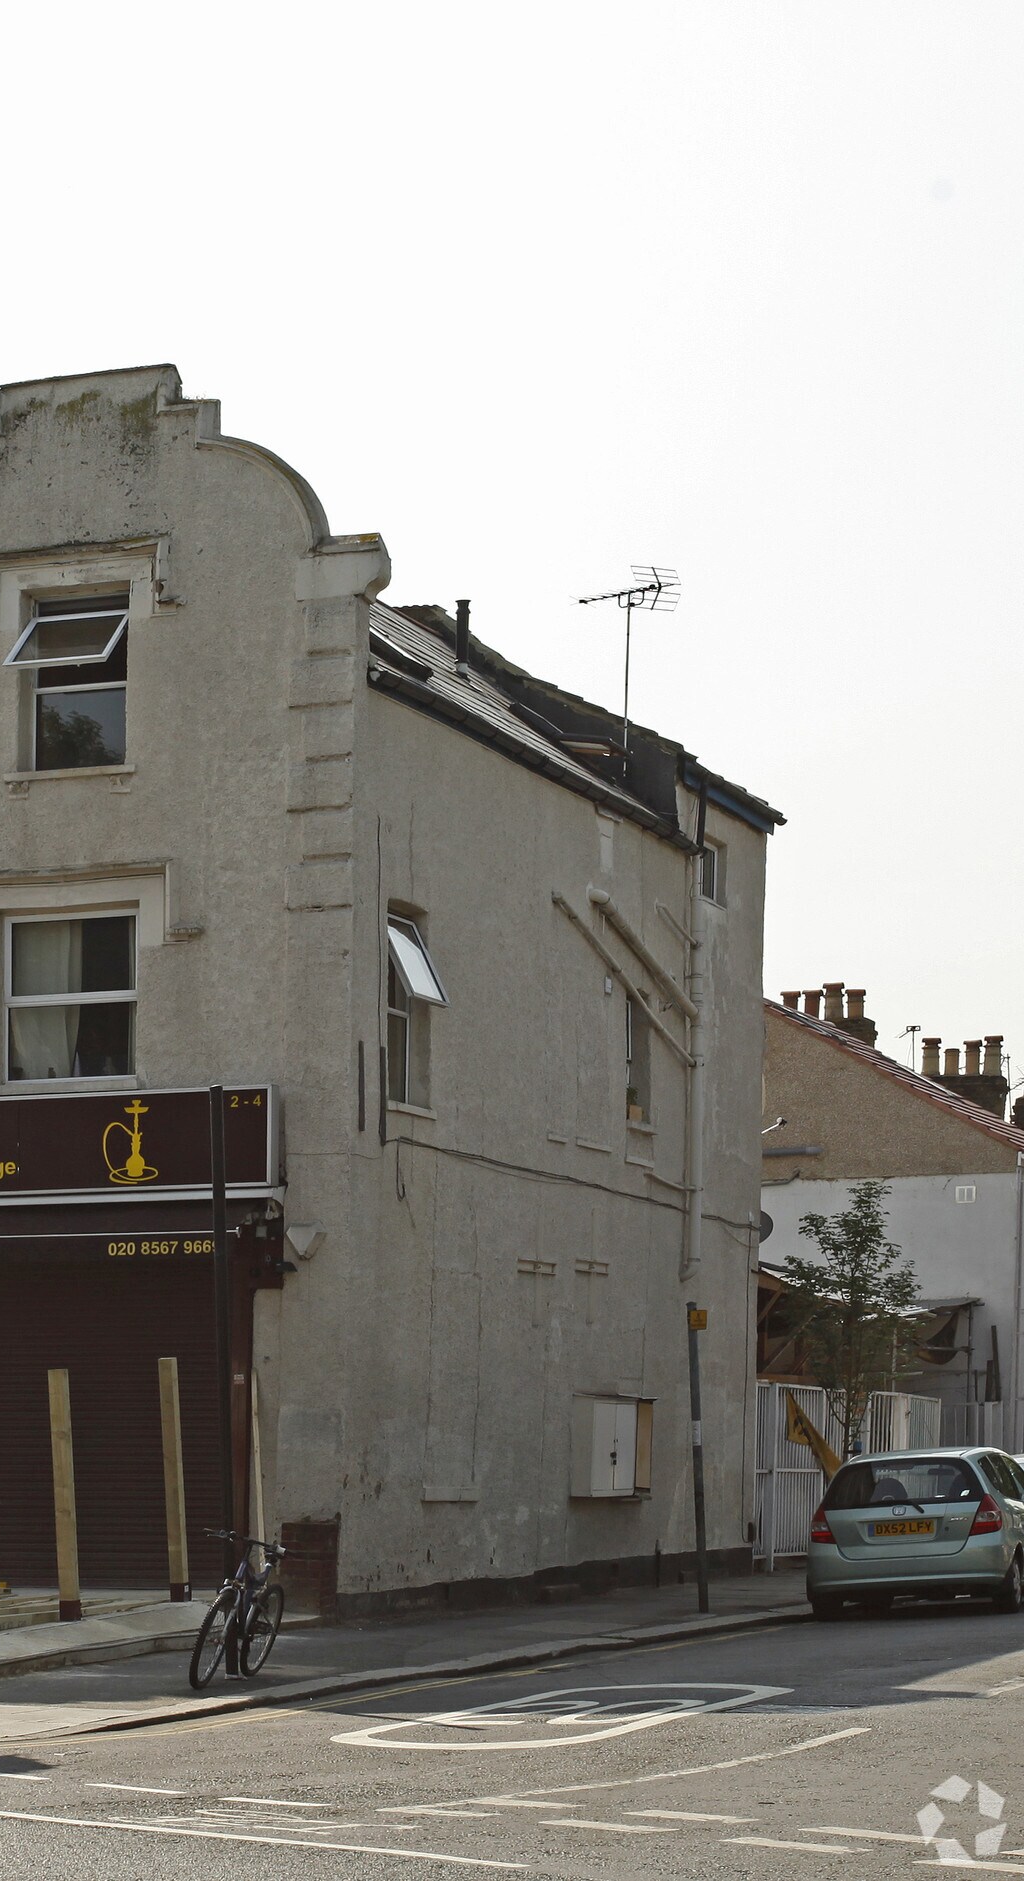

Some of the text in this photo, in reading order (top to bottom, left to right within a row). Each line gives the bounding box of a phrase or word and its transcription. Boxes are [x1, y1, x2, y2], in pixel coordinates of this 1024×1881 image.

[230, 1095, 239, 1108] 2
[252, 1094, 262, 1106] 4
[107, 1241, 136, 1256] 020
[140, 1240, 179, 1255] 8567
[908, 1521, 932, 1533] LFY
